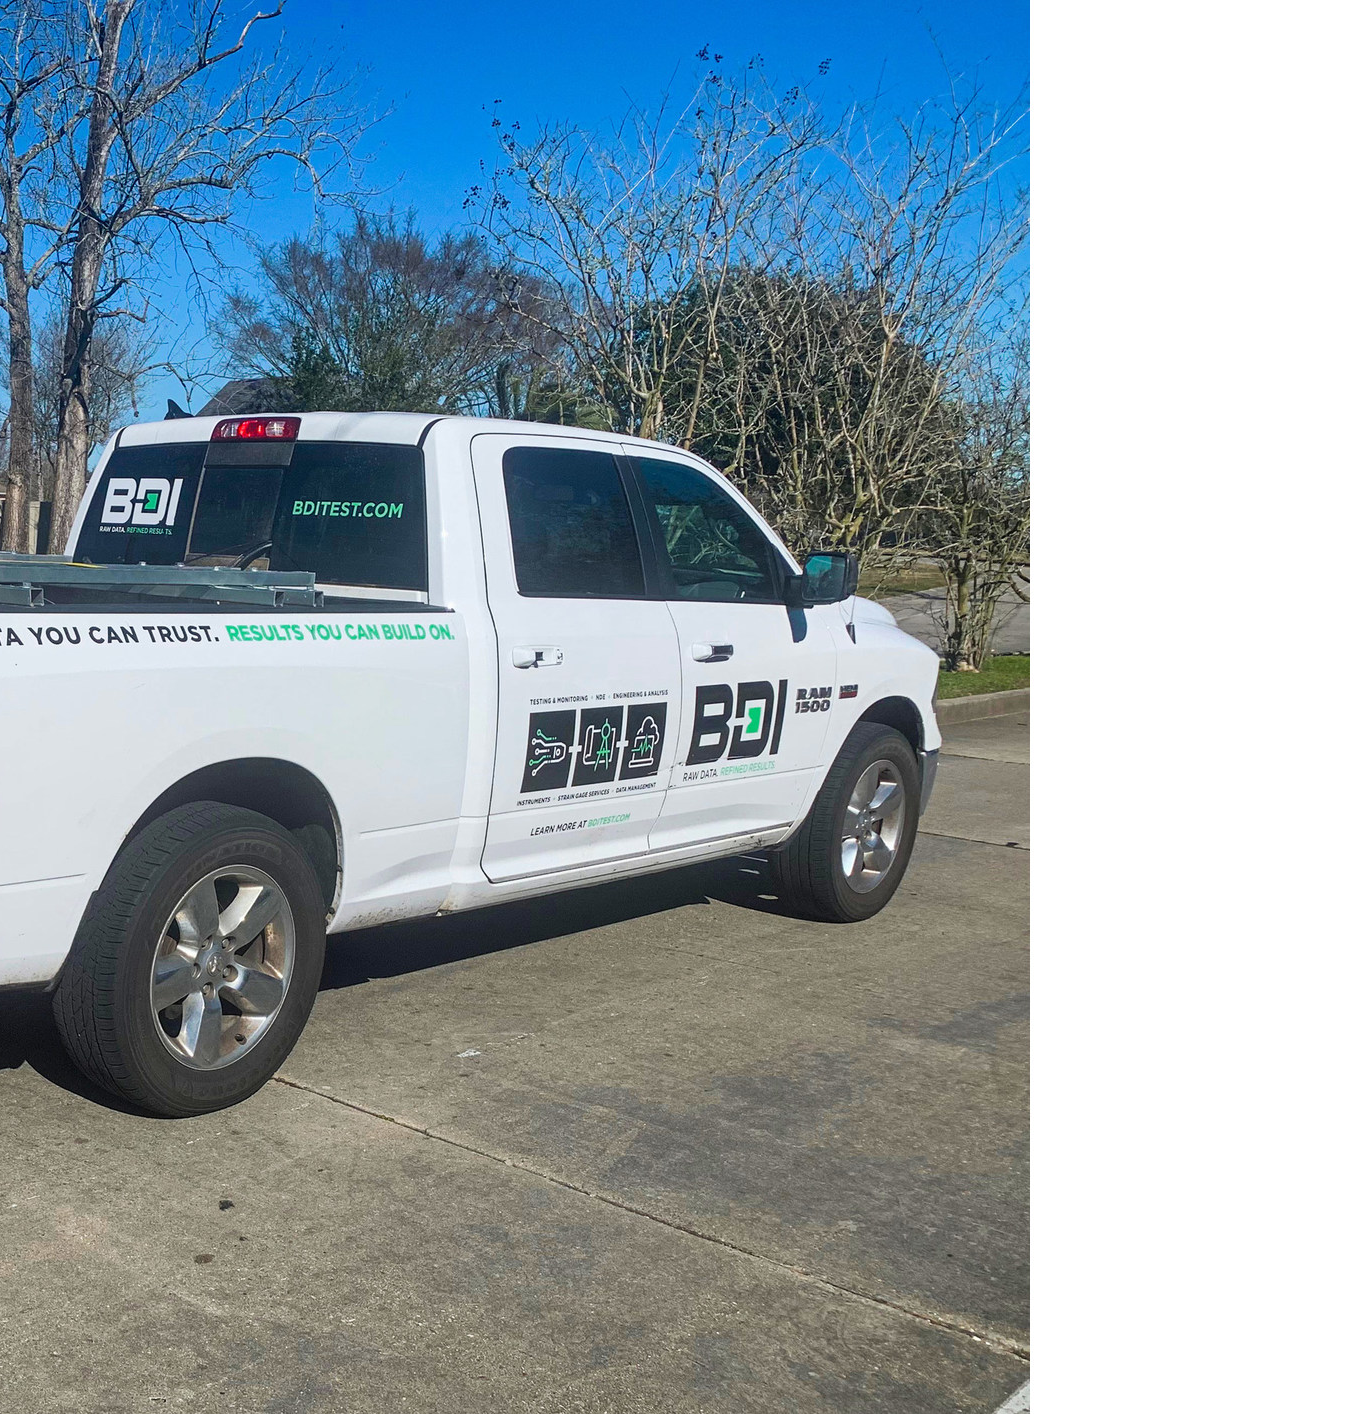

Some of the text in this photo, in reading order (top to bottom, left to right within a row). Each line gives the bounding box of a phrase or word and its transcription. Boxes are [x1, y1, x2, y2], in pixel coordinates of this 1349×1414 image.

[101, 477, 184, 526] BDI
[292, 500, 404, 519] BDITEST.COM
[27, 626, 82, 646] YOU
[88, 626, 140, 644] CAN
[142, 625, 220, 643] TRUST.
[225, 624, 305, 642] RESULTS
[304, 624, 342, 641] YOU
[344, 624, 380, 640] CAN
[380, 624, 426, 640] BUILD
[428, 624, 455, 640] ON.
[530, 697, 551, 705] TESTING
[557, 695, 588, 703] MONITORING
[613, 691, 643, 699] ENGINEERING
[648, 689, 669, 697] ANALYSIS
[796, 687, 832, 701] RAM
[795, 700, 830, 714] 1500
[685, 679, 788, 766] BDI
[683, 770, 700, 782] RAW
[700, 768, 718, 780] DATA.
[720, 764, 748, 776] REFINED
[588, 789, 610, 797] SERVICES
[628, 782, 656, 791] MANAGEMENT
[517, 797, 551, 806] INSTRUMENTS
[530, 813, 631, 836] LEARN MORE AT BDITEST.COM
